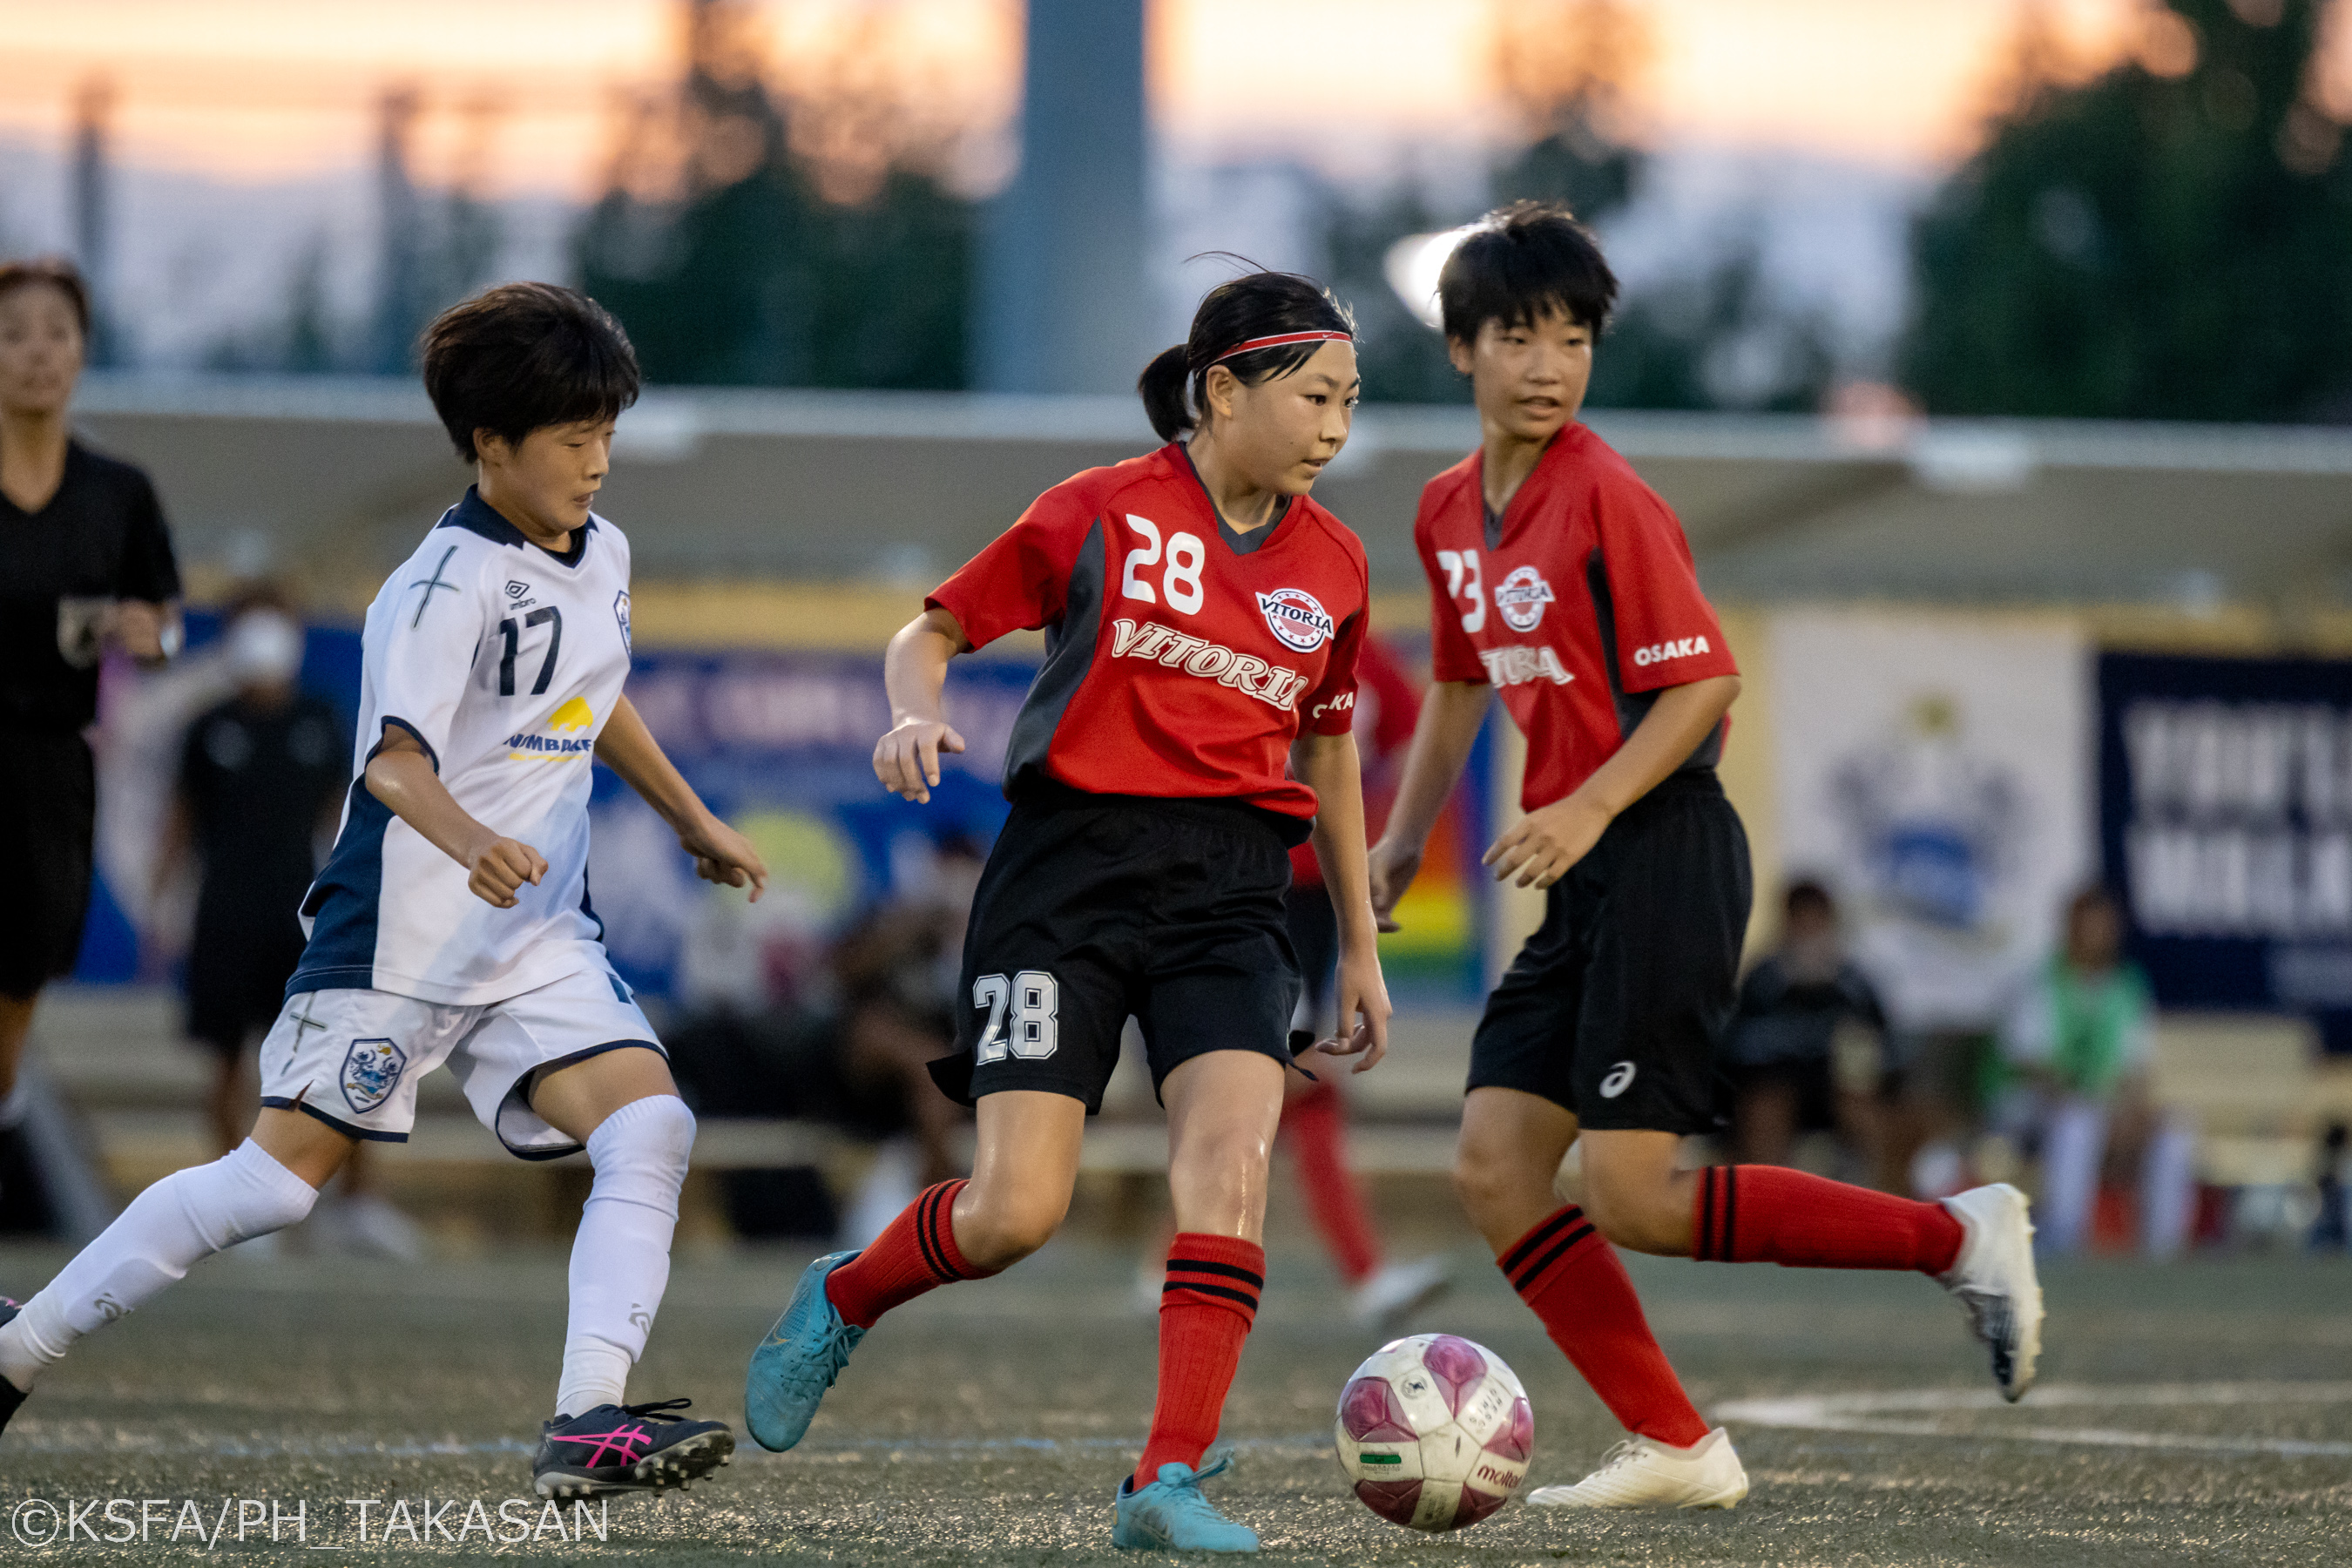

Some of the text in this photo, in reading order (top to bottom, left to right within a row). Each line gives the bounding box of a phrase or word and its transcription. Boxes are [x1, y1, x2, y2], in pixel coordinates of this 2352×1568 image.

[1122, 514, 1205, 615] 28
[499, 605, 562, 697] 17
[1261, 598, 1333, 634] VITORIA
[1633, 635, 1711, 666] OSAKA
[973, 970, 1058, 1065] 28
